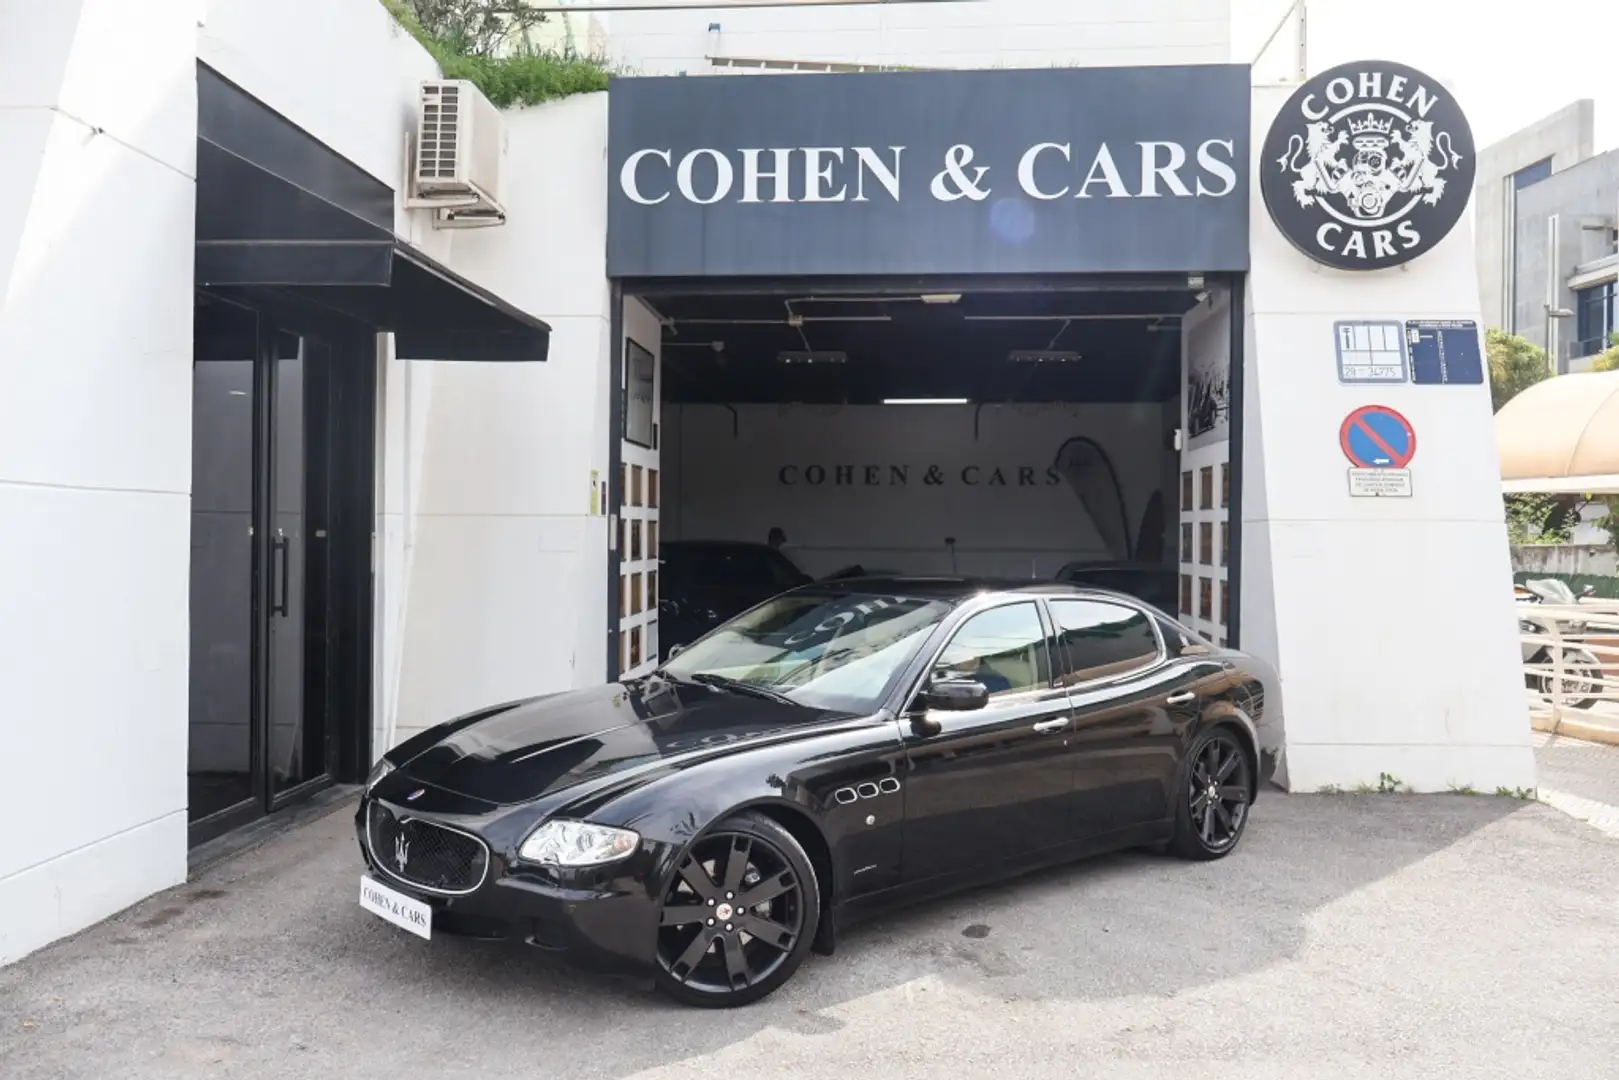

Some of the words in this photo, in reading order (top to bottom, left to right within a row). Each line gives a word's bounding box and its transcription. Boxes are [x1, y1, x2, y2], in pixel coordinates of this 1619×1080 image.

[1301, 72, 1438, 120] COHEN
[620, 145, 906, 205] COHEN
[930, 143, 992, 202] &
[1017, 138, 1237, 200] CARS
[1316, 220, 1421, 259] CARS
[779, 465, 909, 486] COHEN
[922, 464, 945, 486] &
[961, 466, 1061, 486] CARS
[363, 887, 391, 911] COHEN
[392, 901, 400, 915] &
[401, 906, 427, 928] CARS
